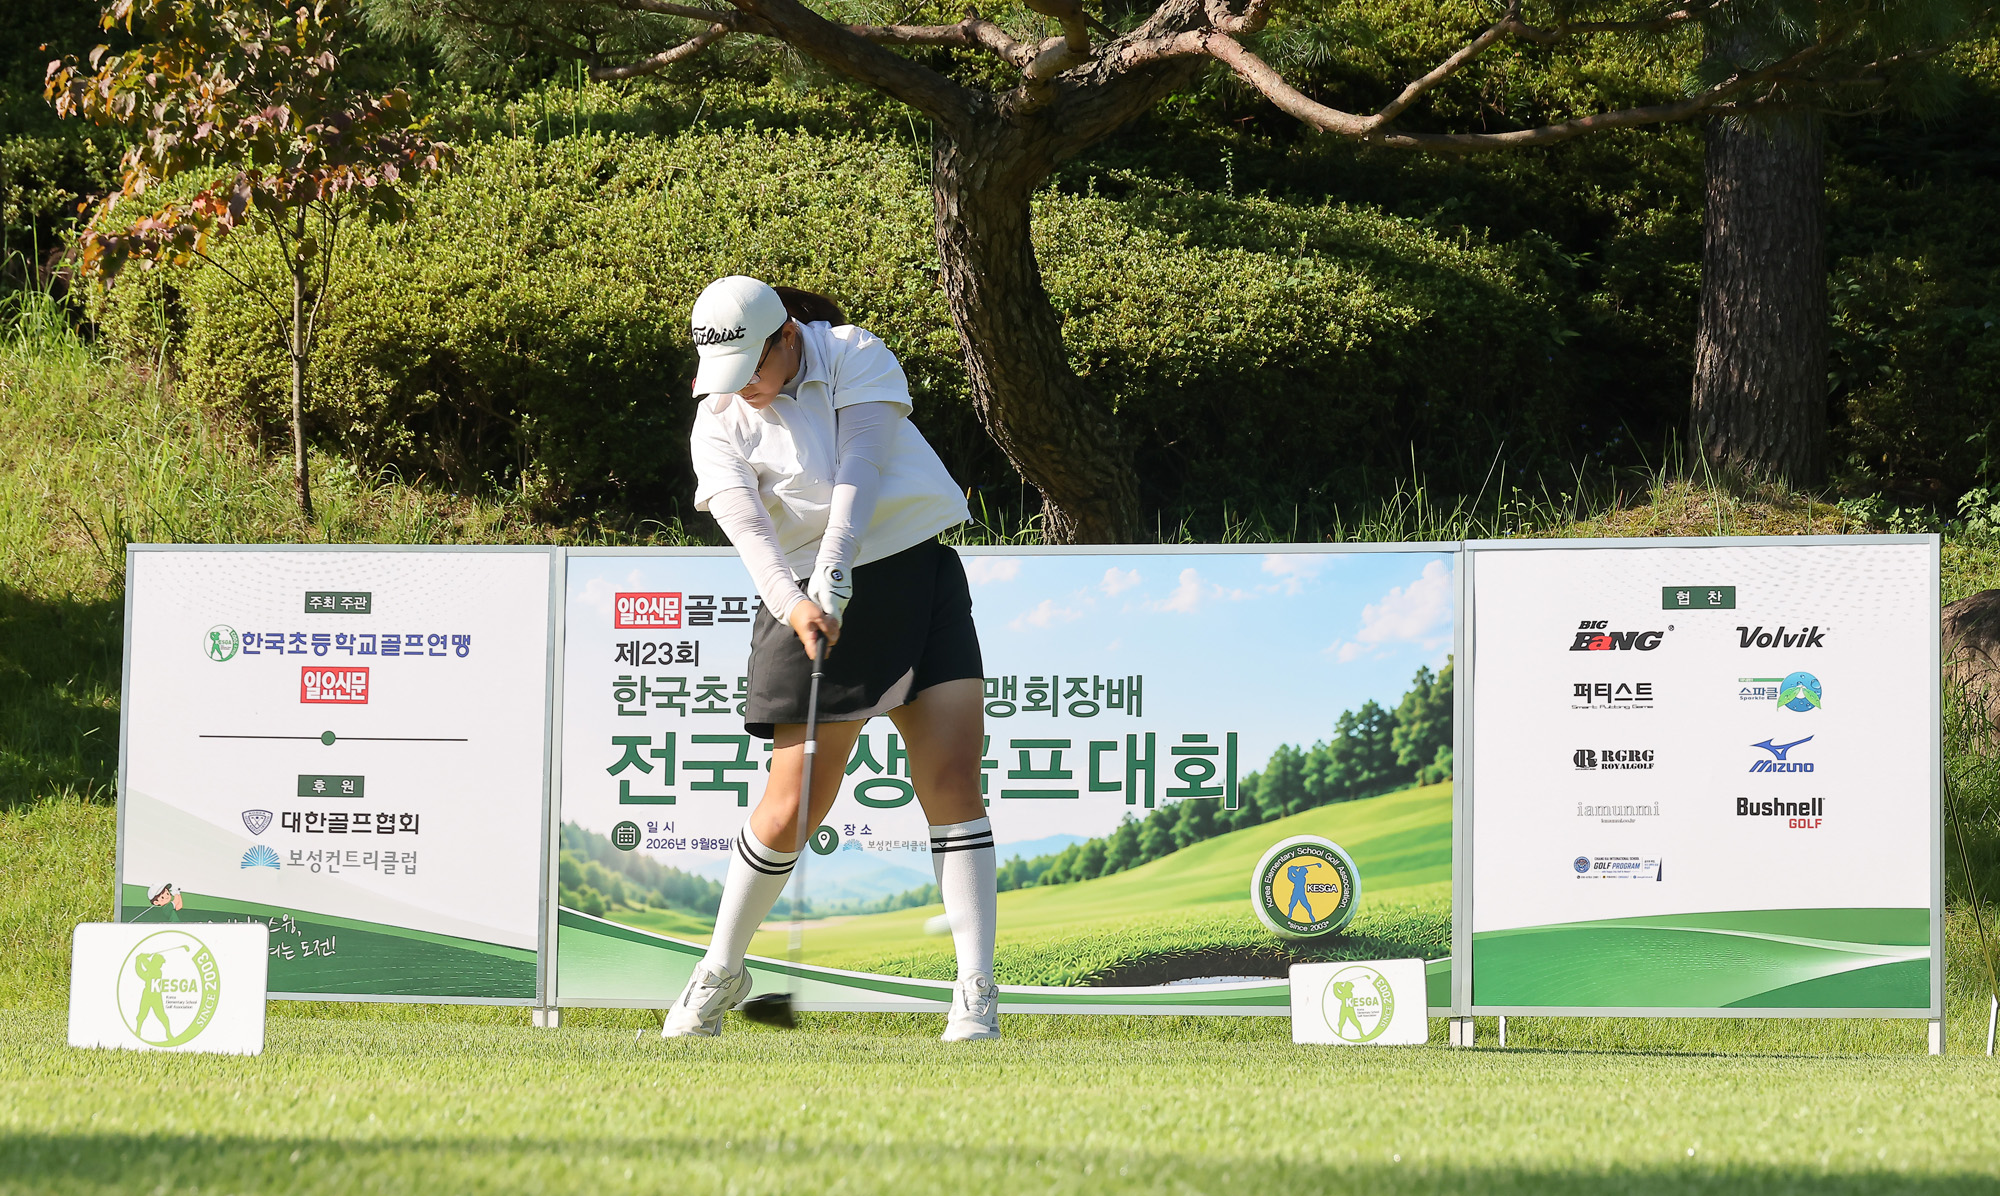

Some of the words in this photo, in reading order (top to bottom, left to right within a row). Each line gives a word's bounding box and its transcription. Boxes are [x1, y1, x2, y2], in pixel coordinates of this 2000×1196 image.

[308, 595, 336, 610] 주최
[340, 596, 368, 611] 주관
[617, 597, 679, 626] 일요신문
[685, 595, 762, 626] 골프
[1578, 620, 1609, 630] BIG
[242, 631, 471, 658] 한국초등학교골프연맹
[1736, 625, 1826, 649] Volvik
[614, 640, 699, 667] 제23회
[303, 670, 367, 701] 일요신문
[1573, 682, 1654, 704] 퍼티스트
[1738, 687, 1778, 700] 스파클
[1601, 749, 1655, 762] RGRG
[1577, 801, 1660, 816] iamunmi
[1736, 797, 1823, 816] Bushnell
[281, 811, 420, 836] 대한골프협회
[1788, 818, 1823, 829] GOLF
[646, 838, 686, 850] 2026년
[691, 837, 735, 851] 9월8일(
[867, 839, 927, 852] 보성컨트리클럽
[1297, 847, 1325, 856] School
[286, 848, 418, 876] 보성컨트리클럽
[1264, 850, 1295, 884] Elementary
[1325, 852, 1340, 866] Golf
[1593, 862, 1612, 870] GOLF
[1612, 862, 1641, 870] PROGRAM
[1264, 885, 1275, 909] Korea
[1307, 884, 1338, 893] KESGA
[268, 913, 302, 937] 스윙,
[300, 935, 337, 958] 도전!
[196, 952, 217, 991] 2003
[150, 978, 198, 993] KESGA
[1376, 979, 1392, 1004] 2003
[196, 993, 216, 1027] SINCE
[1345, 996, 1379, 1008] KESGA
[1380, 1005, 1392, 1028] SINCE
